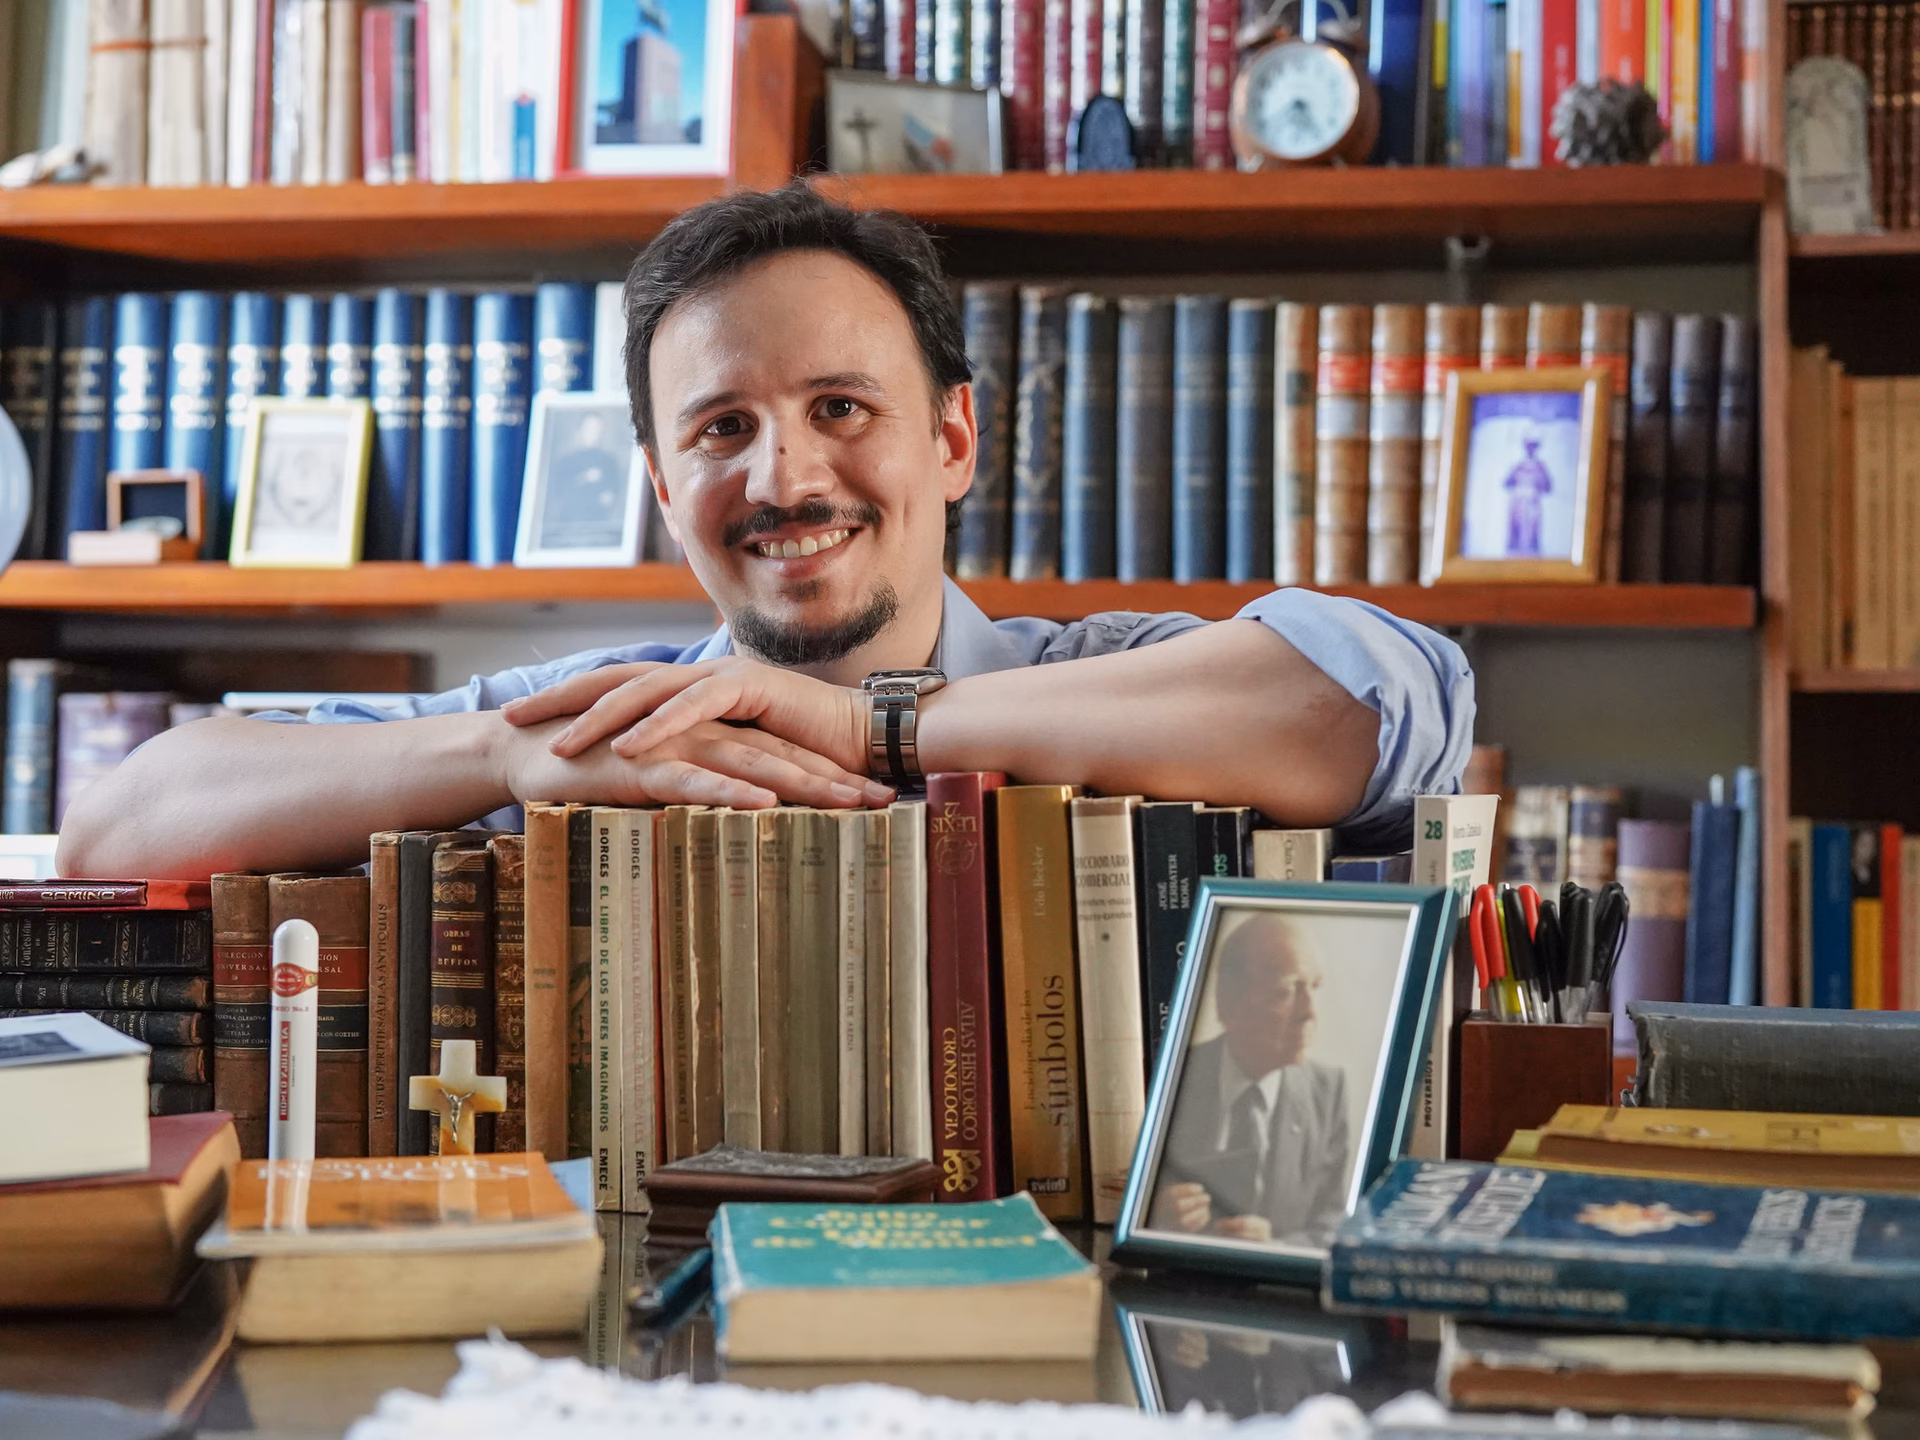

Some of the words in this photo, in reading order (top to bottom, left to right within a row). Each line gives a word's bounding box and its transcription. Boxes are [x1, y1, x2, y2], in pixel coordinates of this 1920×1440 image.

[932, 816, 977, 833] LEXIS
[1425, 820, 1443, 840] 28
[600, 828, 609, 878] BORGES
[631, 830, 640, 879] BORGES
[1032, 845, 1044, 886] Becker
[600, 885, 609, 900] EL
[1157, 882, 1168, 910] JOSÉ
[1168, 854, 1178, 909] FERRATER
[1180, 878, 1190, 909] MORA
[377, 904, 388, 971] ANTIQUUS
[600, 906, 609, 944] LIBRO
[632, 887, 640, 972] LITERATURAS
[600, 950, 609, 965] DE
[600, 970, 608, 994] LOS
[374, 975, 387, 1073] PERTHES/ATLAS
[600, 1001, 608, 1040] SERES
[960, 1000, 976, 1048] ATLAS
[281, 1026, 289, 1072] JULIETA
[1036, 974, 1068, 1127] símbolos
[280, 1081, 288, 1116] ROMEO
[374, 1076, 386, 1122] JUSTUS
[600, 1046, 608, 1132] IMAGINARIOS
[942, 1027, 958, 1139] CRONOLOGIA
[961, 1052, 977, 1141] HISTORICO
[1423, 1060, 1432, 1127] PROVERBIOS
